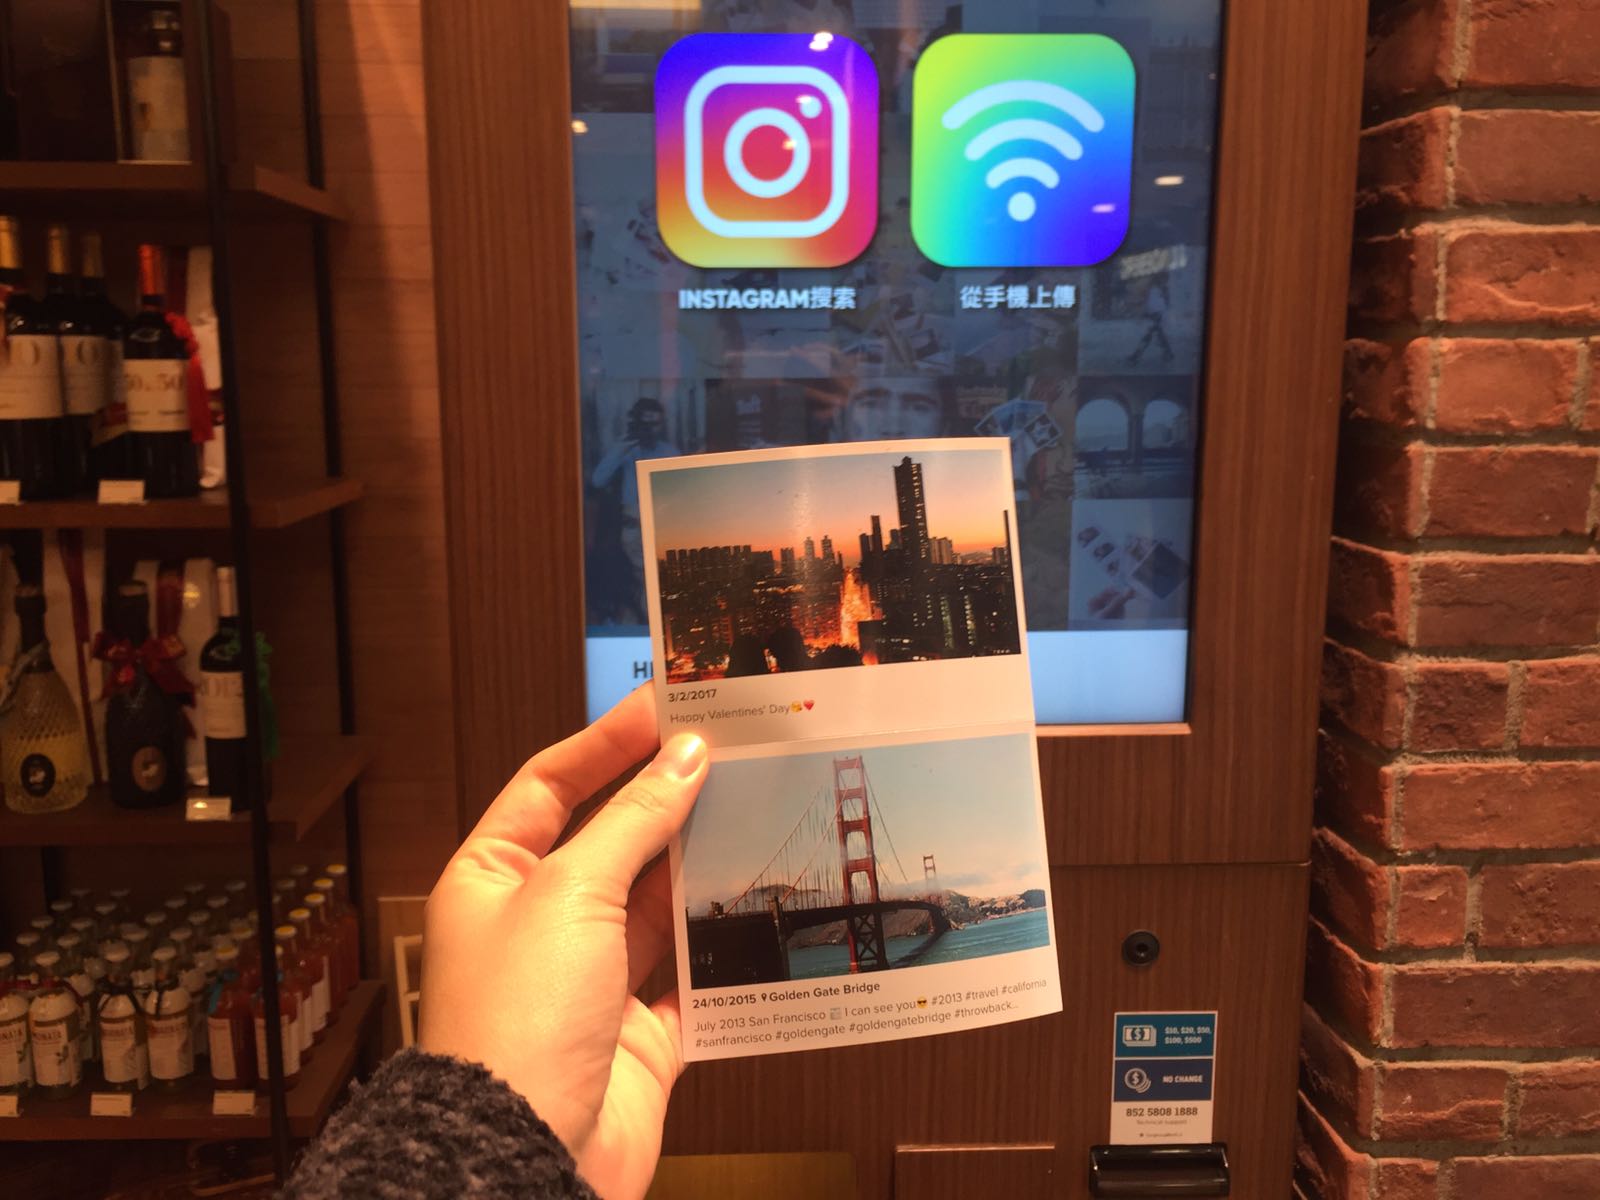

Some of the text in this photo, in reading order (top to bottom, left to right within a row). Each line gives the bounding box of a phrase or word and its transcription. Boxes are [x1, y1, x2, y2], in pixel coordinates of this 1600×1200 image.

[959, 284, 1077, 310] 從手機上傳
[668, 689, 717, 702] 3/2/2017
[670, 704, 790, 724] Happy Valentines' Day
[692, 982, 880, 1009] 24/10/2015 Golden Gate Bridge
[694, 1020, 716, 1033] July
[720, 1017, 746, 1030] 2013
[749, 1016, 770, 1027] San
[773, 1011, 826, 1025] Francisco
[851, 1007, 871, 1017] can
[873, 1004, 894, 1014] see
[895, 1000, 916, 1012] you
[931, 992, 963, 1006] #2013
[965, 987, 999, 1001] #travel
[1001, 978, 1047, 995] #california
[695, 1032, 772, 1048] #sanfrancisco
[775, 1024, 846, 1042] #goldengate
[849, 1012, 952, 1033] #goldengatebridge
[1162, 1075, 1203, 1083] NO CHANGE
[1126, 1107, 1198, 1117] 852 5808 1888
